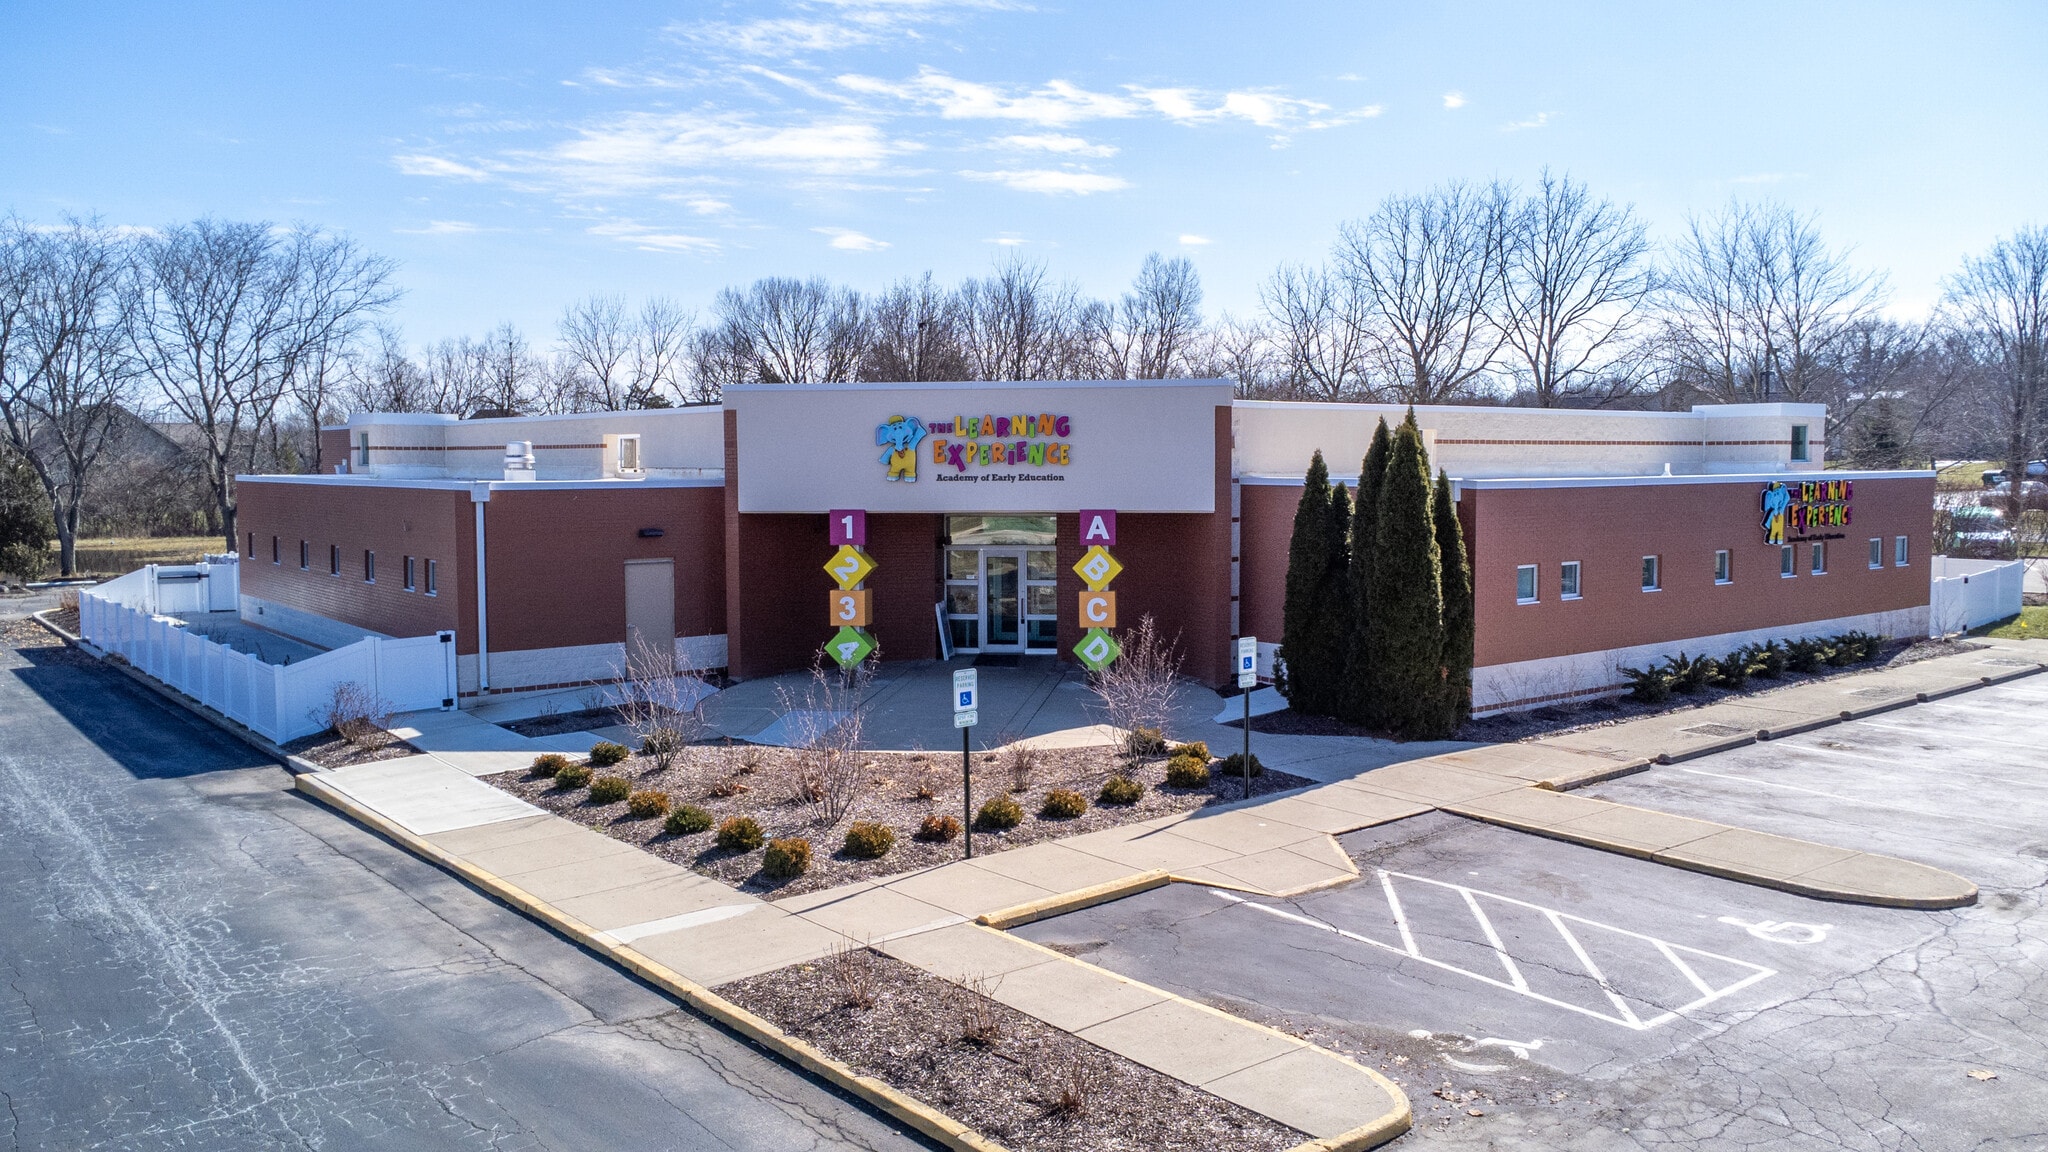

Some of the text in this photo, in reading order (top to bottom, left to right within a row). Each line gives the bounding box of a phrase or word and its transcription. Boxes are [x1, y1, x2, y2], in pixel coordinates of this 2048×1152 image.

[929, 422, 953, 434] THE
[936, 473, 1065, 483] Academy of Early Education
[841, 515, 853, 539] 1
[1086, 515, 1110, 540] A
[833, 557, 859, 582] 2
[1083, 554, 1110, 581] B
[839, 596, 857, 620] 3
[1086, 597, 1108, 622] C
[837, 640, 860, 661] 4
[1083, 636, 1109, 662] D
